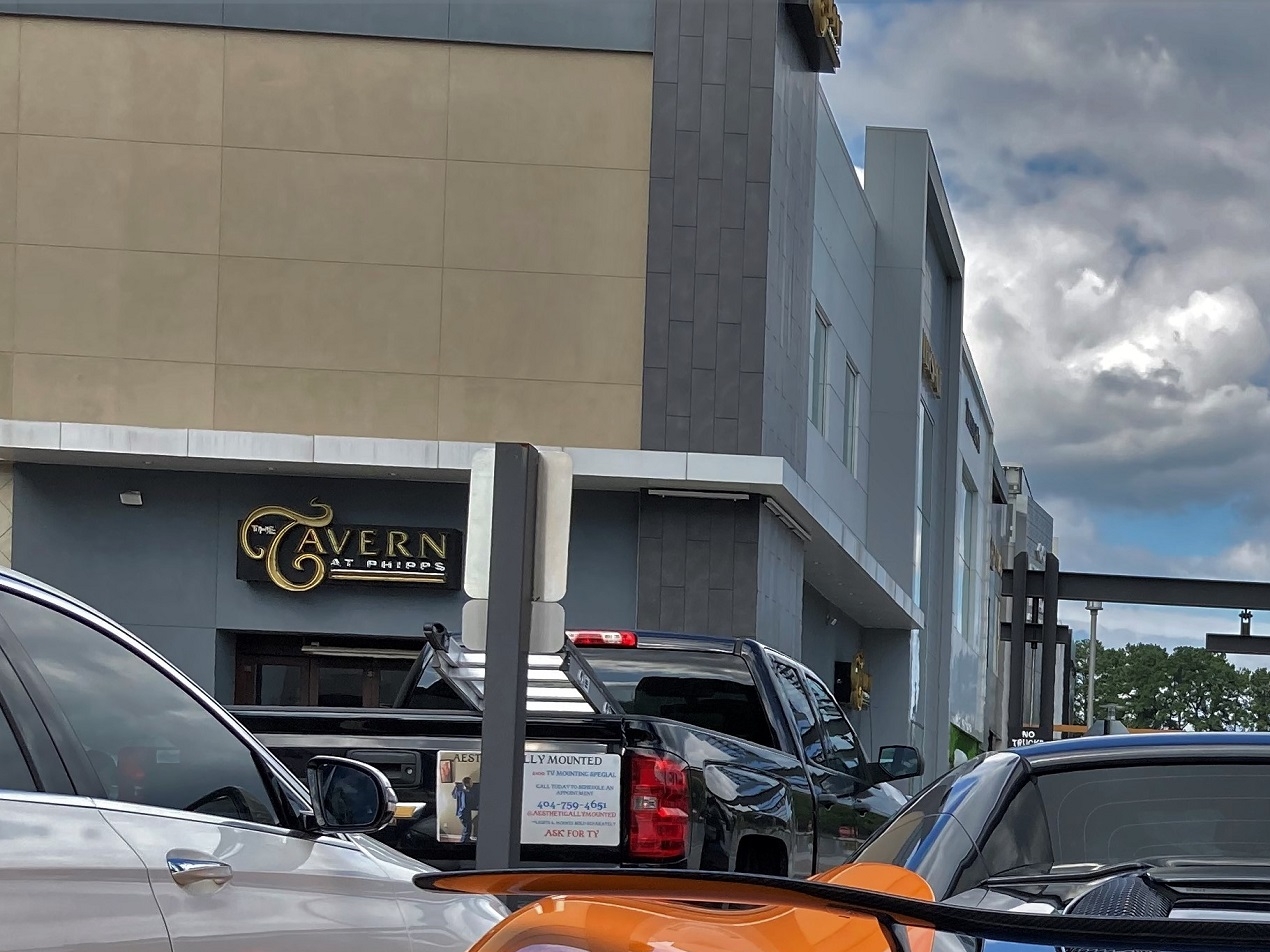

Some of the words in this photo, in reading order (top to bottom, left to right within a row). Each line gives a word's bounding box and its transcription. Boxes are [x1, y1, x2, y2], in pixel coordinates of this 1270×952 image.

[251, 524, 277, 535] THE
[240, 497, 448, 592] TAVERN
[330, 558, 354, 567] AT
[366, 559, 446, 571] PHIPPS
[1021, 730, 1036, 738] NO
[549, 755, 603, 766] MOUNTED
[537, 800, 607, 811] 404-759-4651
[527, 810, 617, 818] @AESTHETICALLYMOUNTED
[544, 829, 565, 837] ASK
[567, 829, 585, 838] FOR
[586, 829, 600, 838] TY
